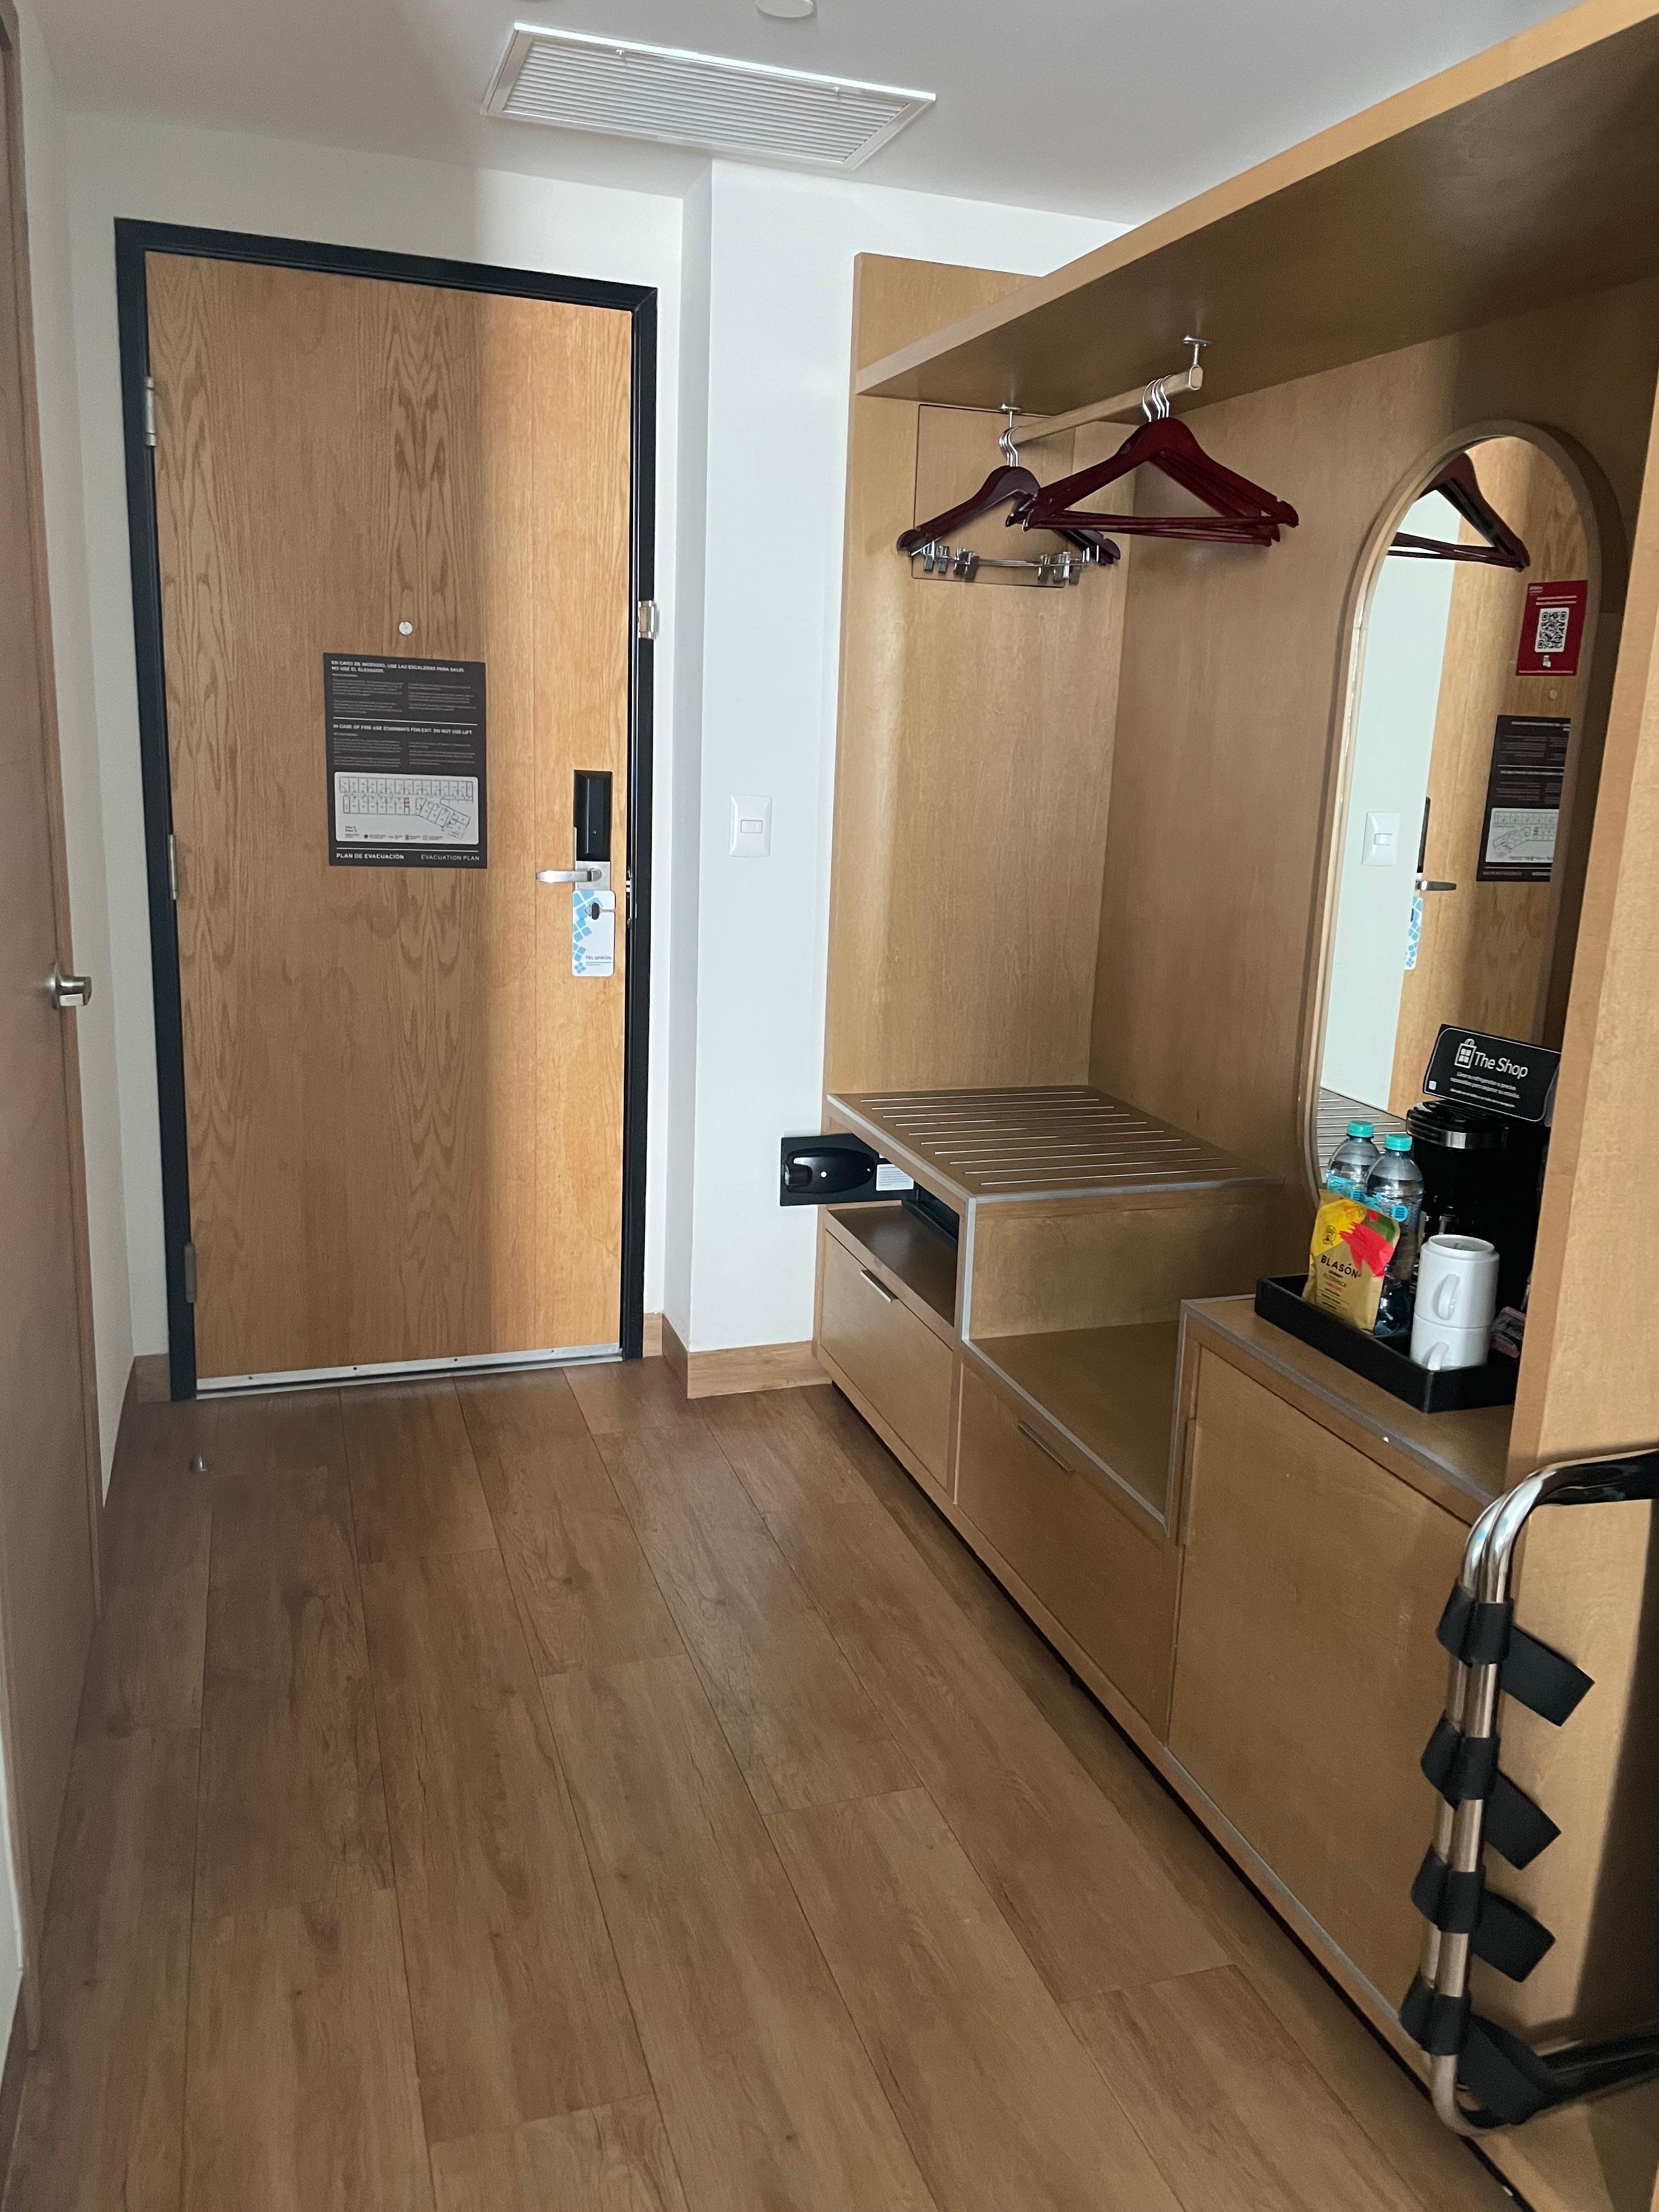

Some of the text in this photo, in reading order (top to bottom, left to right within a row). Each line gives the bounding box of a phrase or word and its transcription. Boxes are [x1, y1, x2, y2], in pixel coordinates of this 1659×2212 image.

[1474, 1052, 1528, 1079] The Shop
[1321, 1255, 1359, 1279] BLASÓN
